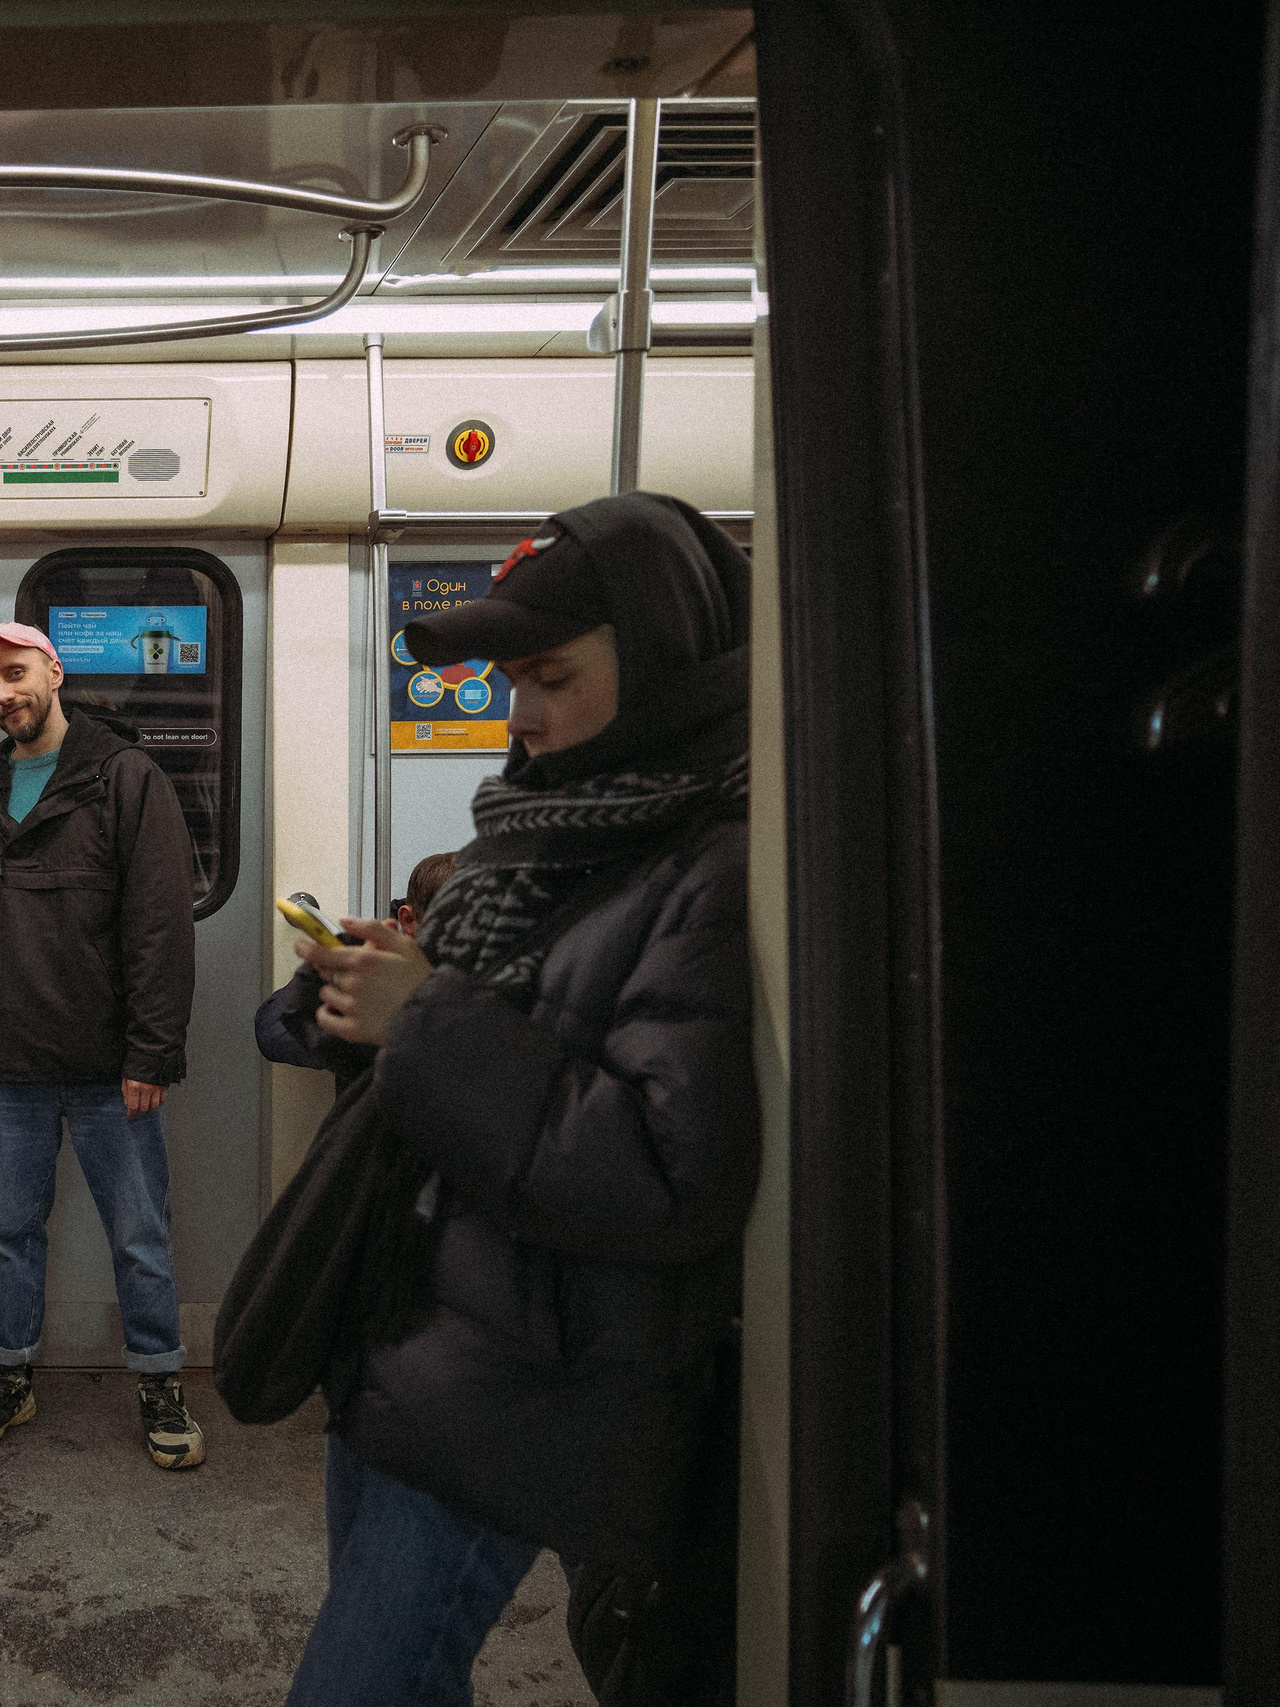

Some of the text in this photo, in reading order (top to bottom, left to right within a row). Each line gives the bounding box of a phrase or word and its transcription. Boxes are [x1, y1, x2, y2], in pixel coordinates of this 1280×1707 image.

[17, 419, 55, 457] ВАСИЛЕОСТРОВСКАЯ
[52, 431, 78, 457] ПРИМОРСКАЯ
[87, 443, 100, 457] ЗЕНИТ
[110, 439, 129, 457] БЕГОВАЯ
[427, 579, 466, 595] Один
[402, 601, 410, 610] в
[414, 600, 450, 610] поле
